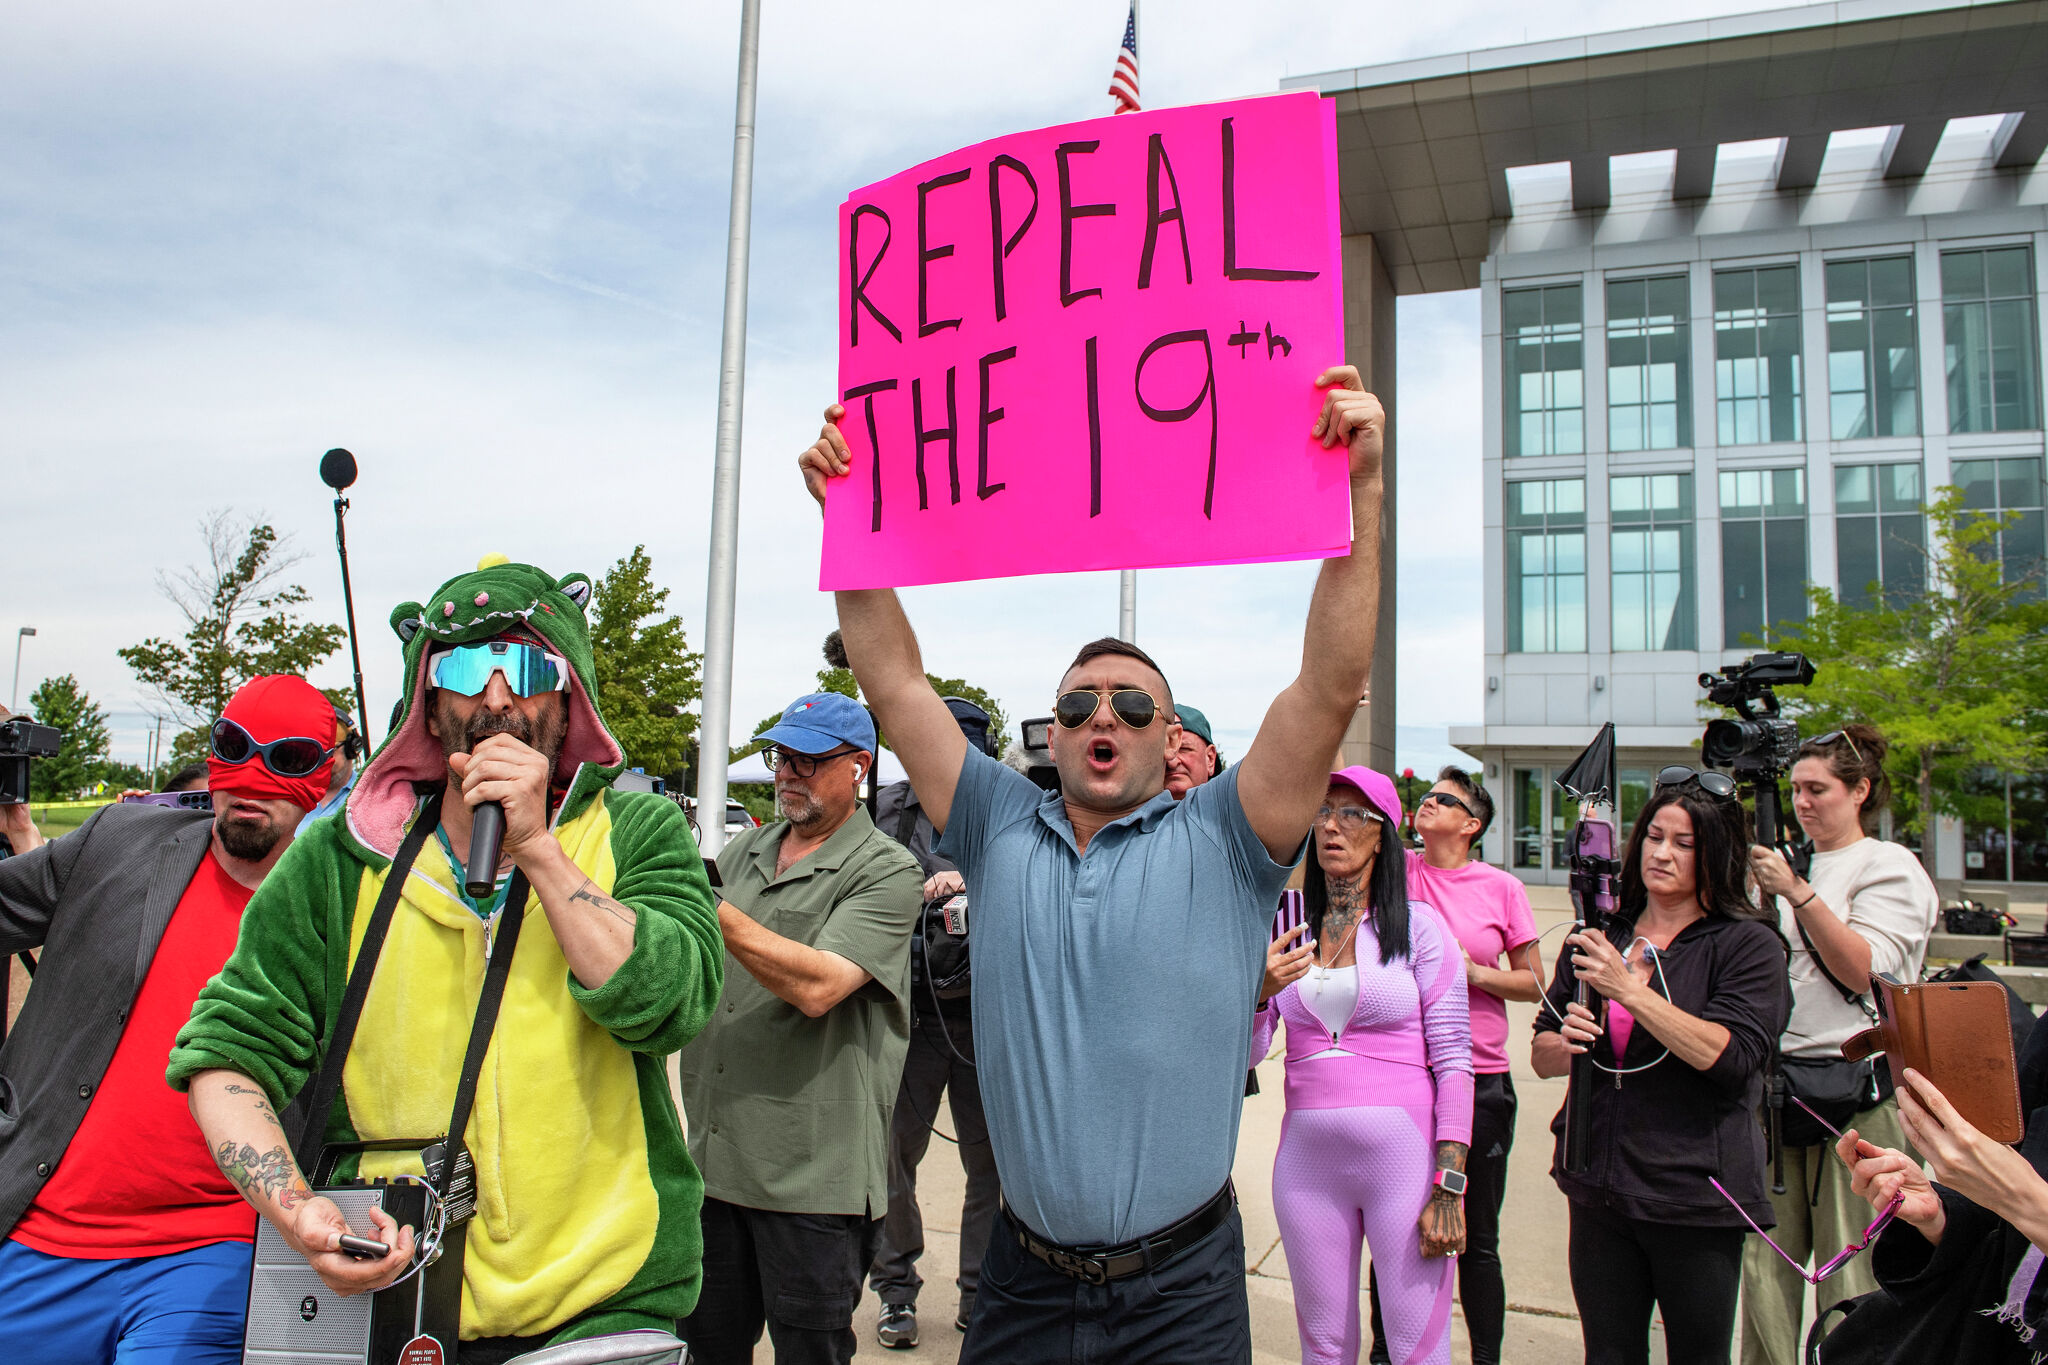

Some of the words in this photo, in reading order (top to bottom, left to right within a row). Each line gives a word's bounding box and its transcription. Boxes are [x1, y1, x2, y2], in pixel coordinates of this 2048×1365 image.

[850, 117, 1320, 347] REPEAL
[844, 346, 1017, 532] THE
[1086, 320, 1292, 520] 19th
[950, 910, 961, 931] INSIDE
